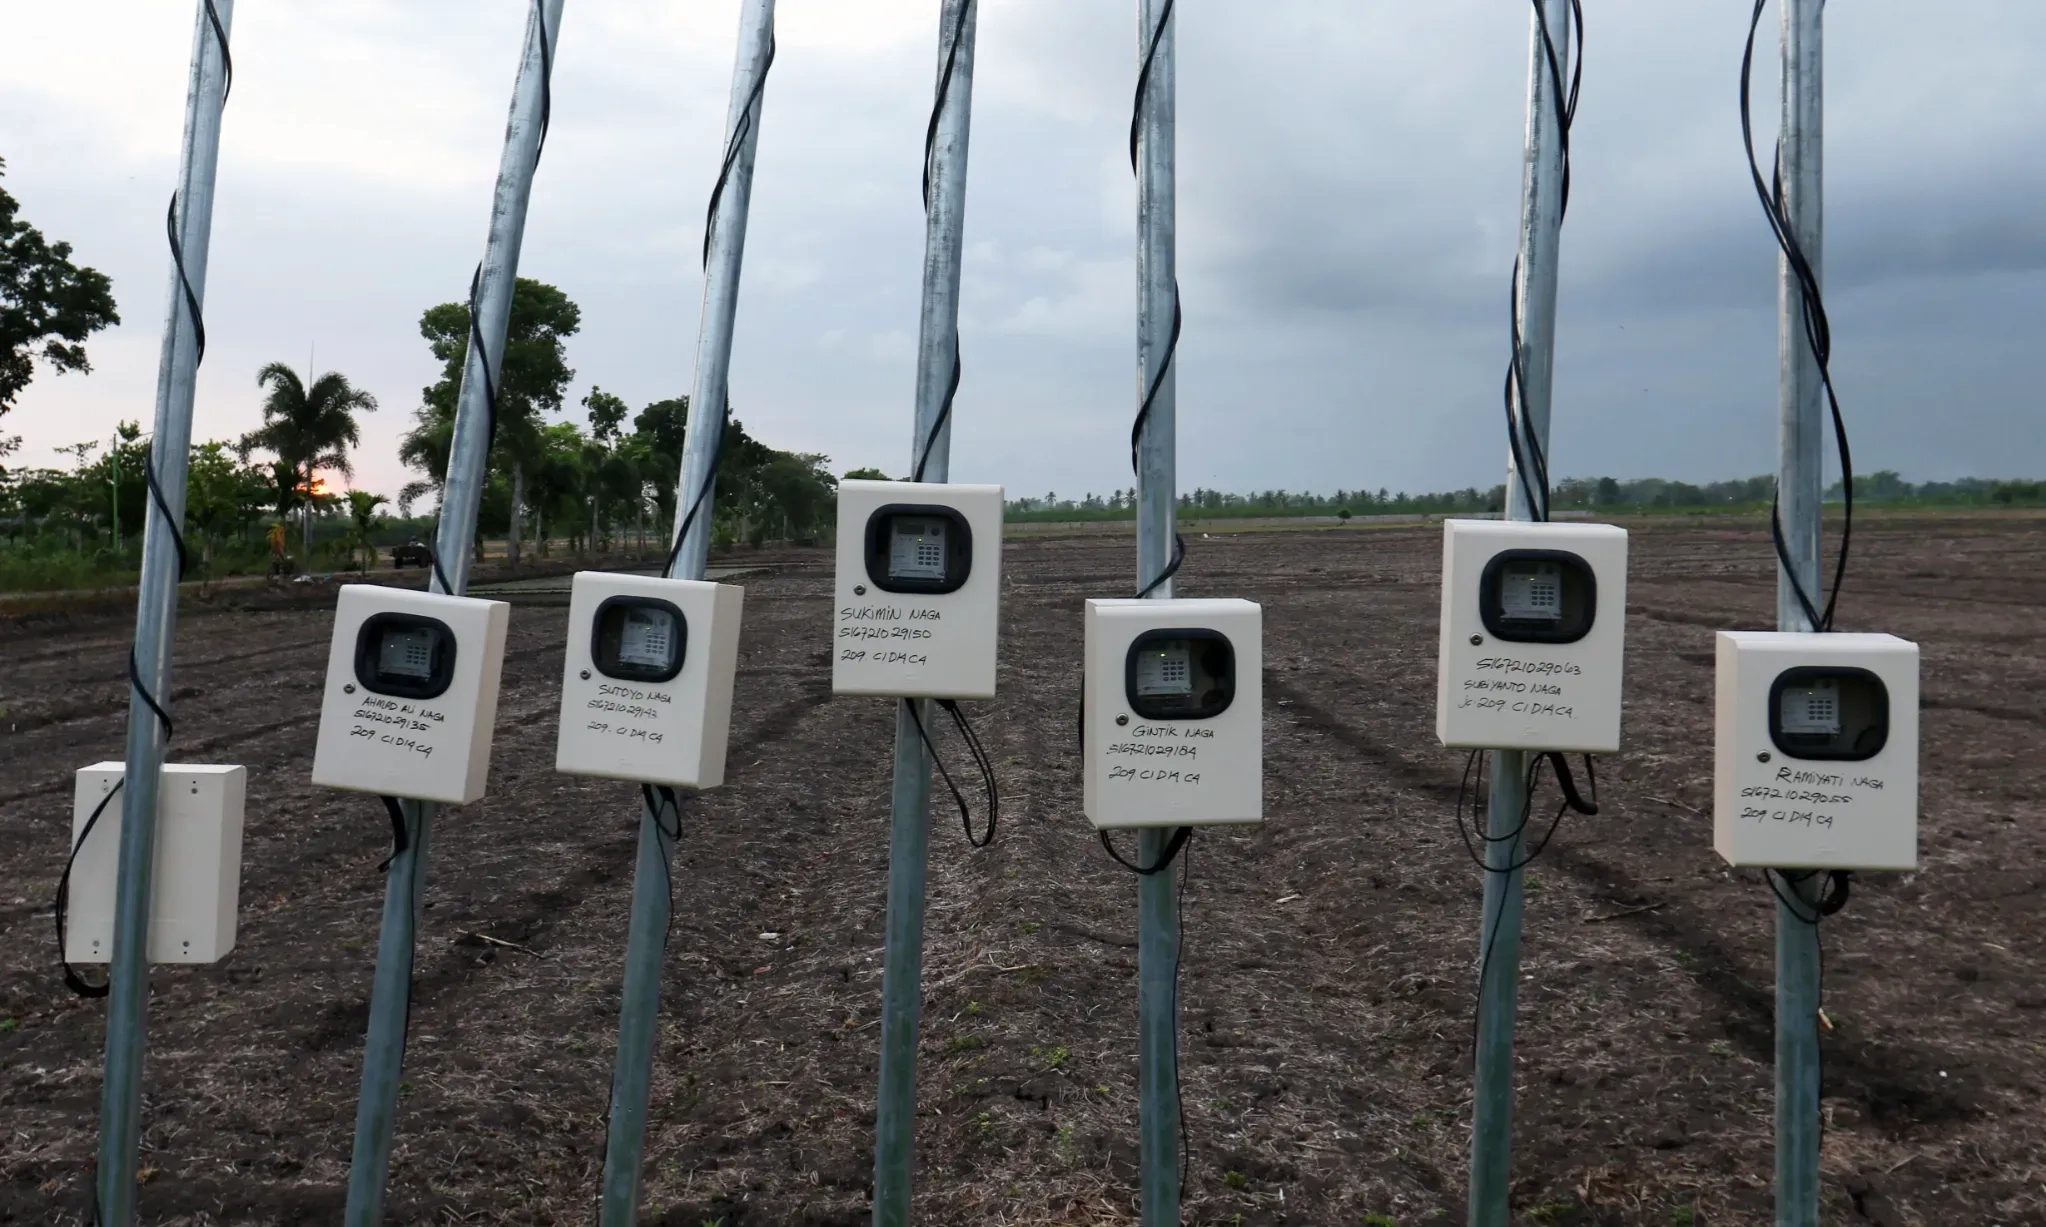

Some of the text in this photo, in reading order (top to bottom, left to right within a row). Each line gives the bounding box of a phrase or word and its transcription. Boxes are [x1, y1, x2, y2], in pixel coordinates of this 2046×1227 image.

[908, 609, 941, 621] NAGA
[1476, 657, 1582, 676] 516721029063
[598, 684, 671, 704] SUTOYO NAGA
[1530, 683, 1562, 696] NAGA
[362, 696, 398, 711] AHMAD
[419, 709, 445, 722] NAGA
[354, 709, 431, 731] 516721029135
[1184, 728, 1214, 739] NAGA
[1851, 777, 1884, 790] NAGA
